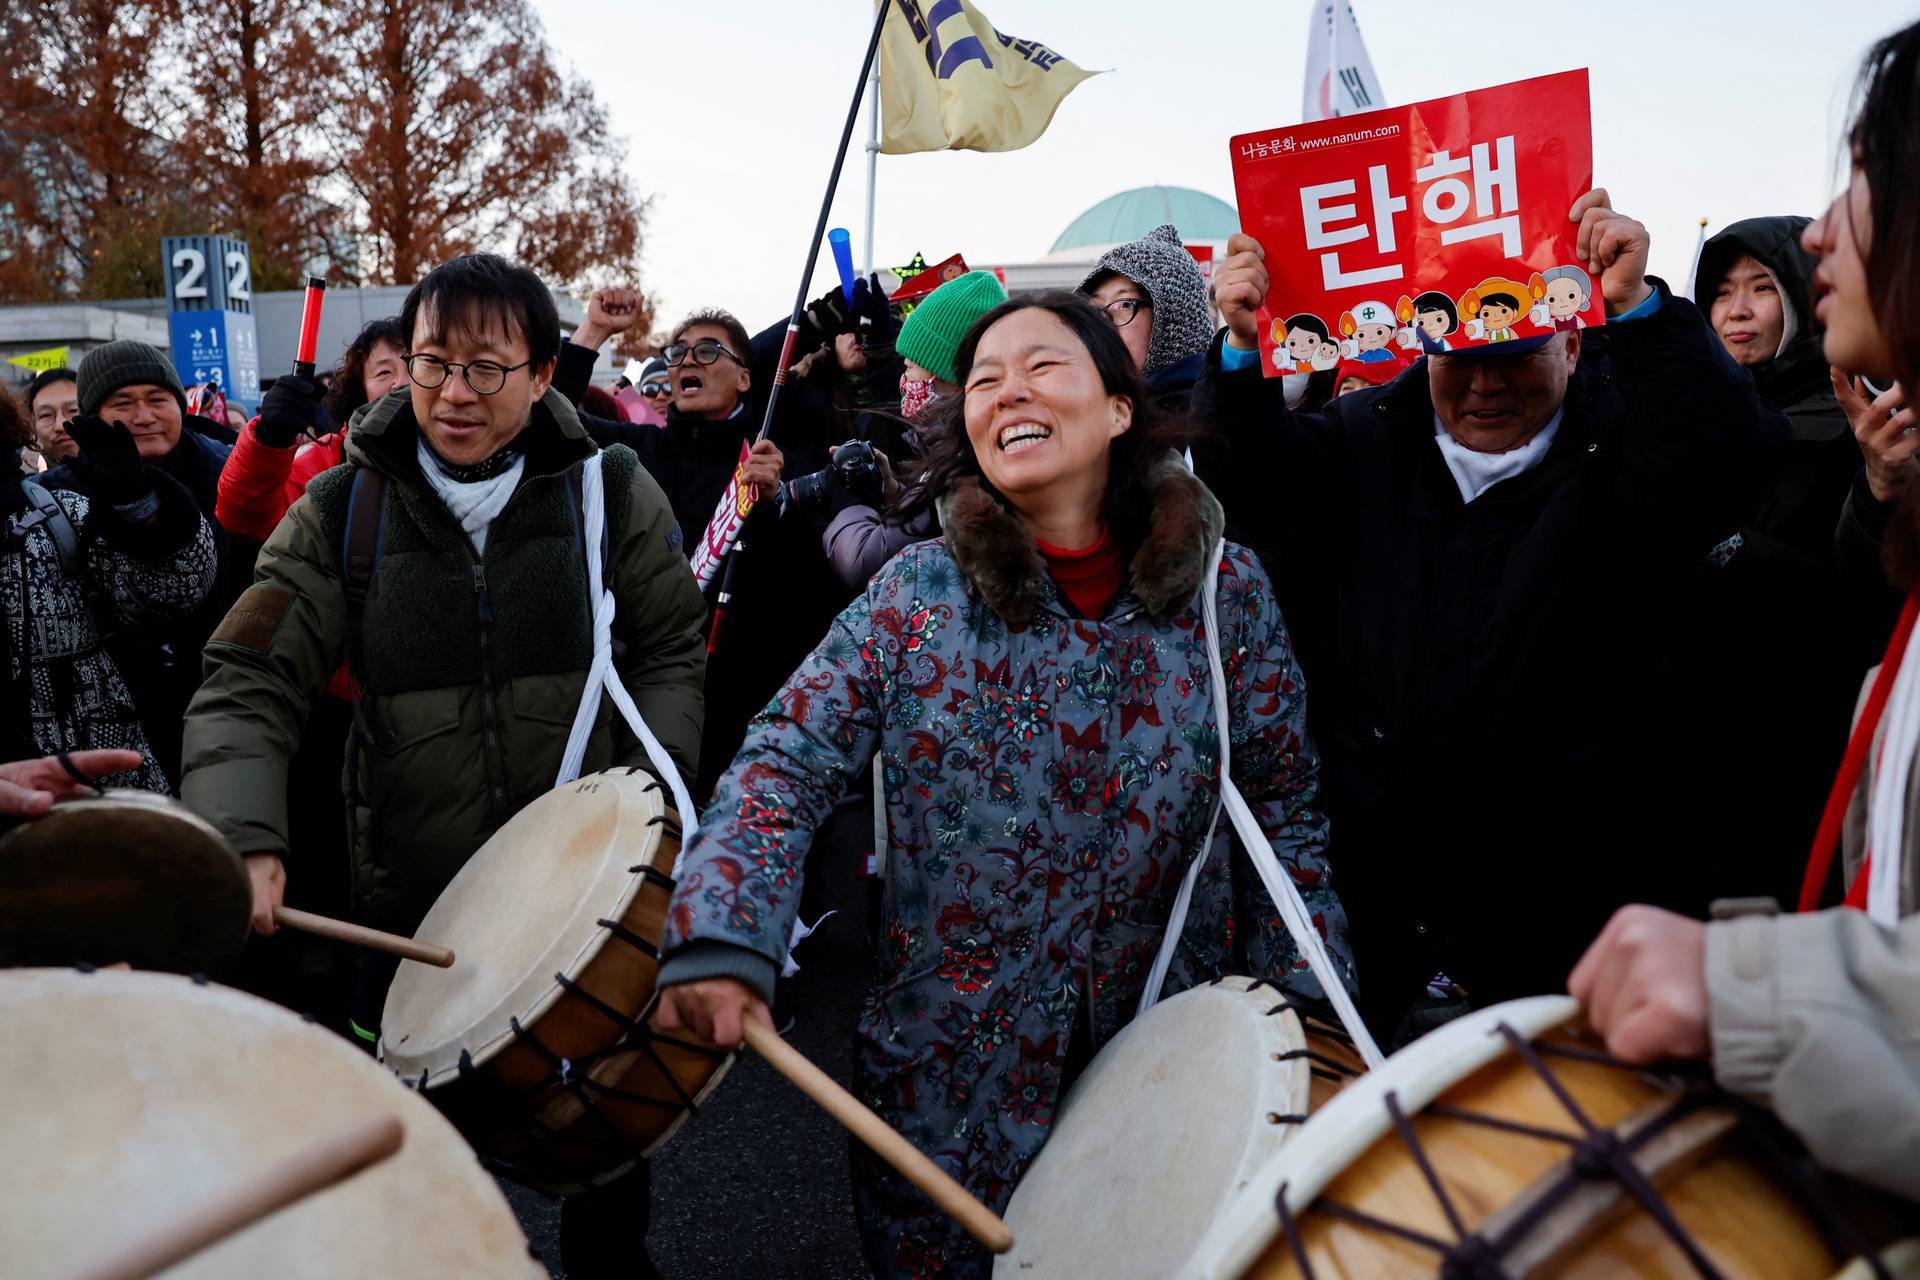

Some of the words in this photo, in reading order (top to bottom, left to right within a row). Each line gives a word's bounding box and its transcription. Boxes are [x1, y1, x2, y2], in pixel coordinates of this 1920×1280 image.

[1242, 136, 1297, 159] 나눔문화
[1300, 124, 1400, 150] www.nanum.com
[1300, 135, 1522, 291] 탄핵
[173, 249, 207, 298] 2
[225, 251, 250, 300] 2
[210, 327, 218, 348] 1
[247, 331, 253, 350] 1
[210, 366, 223, 387] 3
[248, 369, 257, 389] 3
